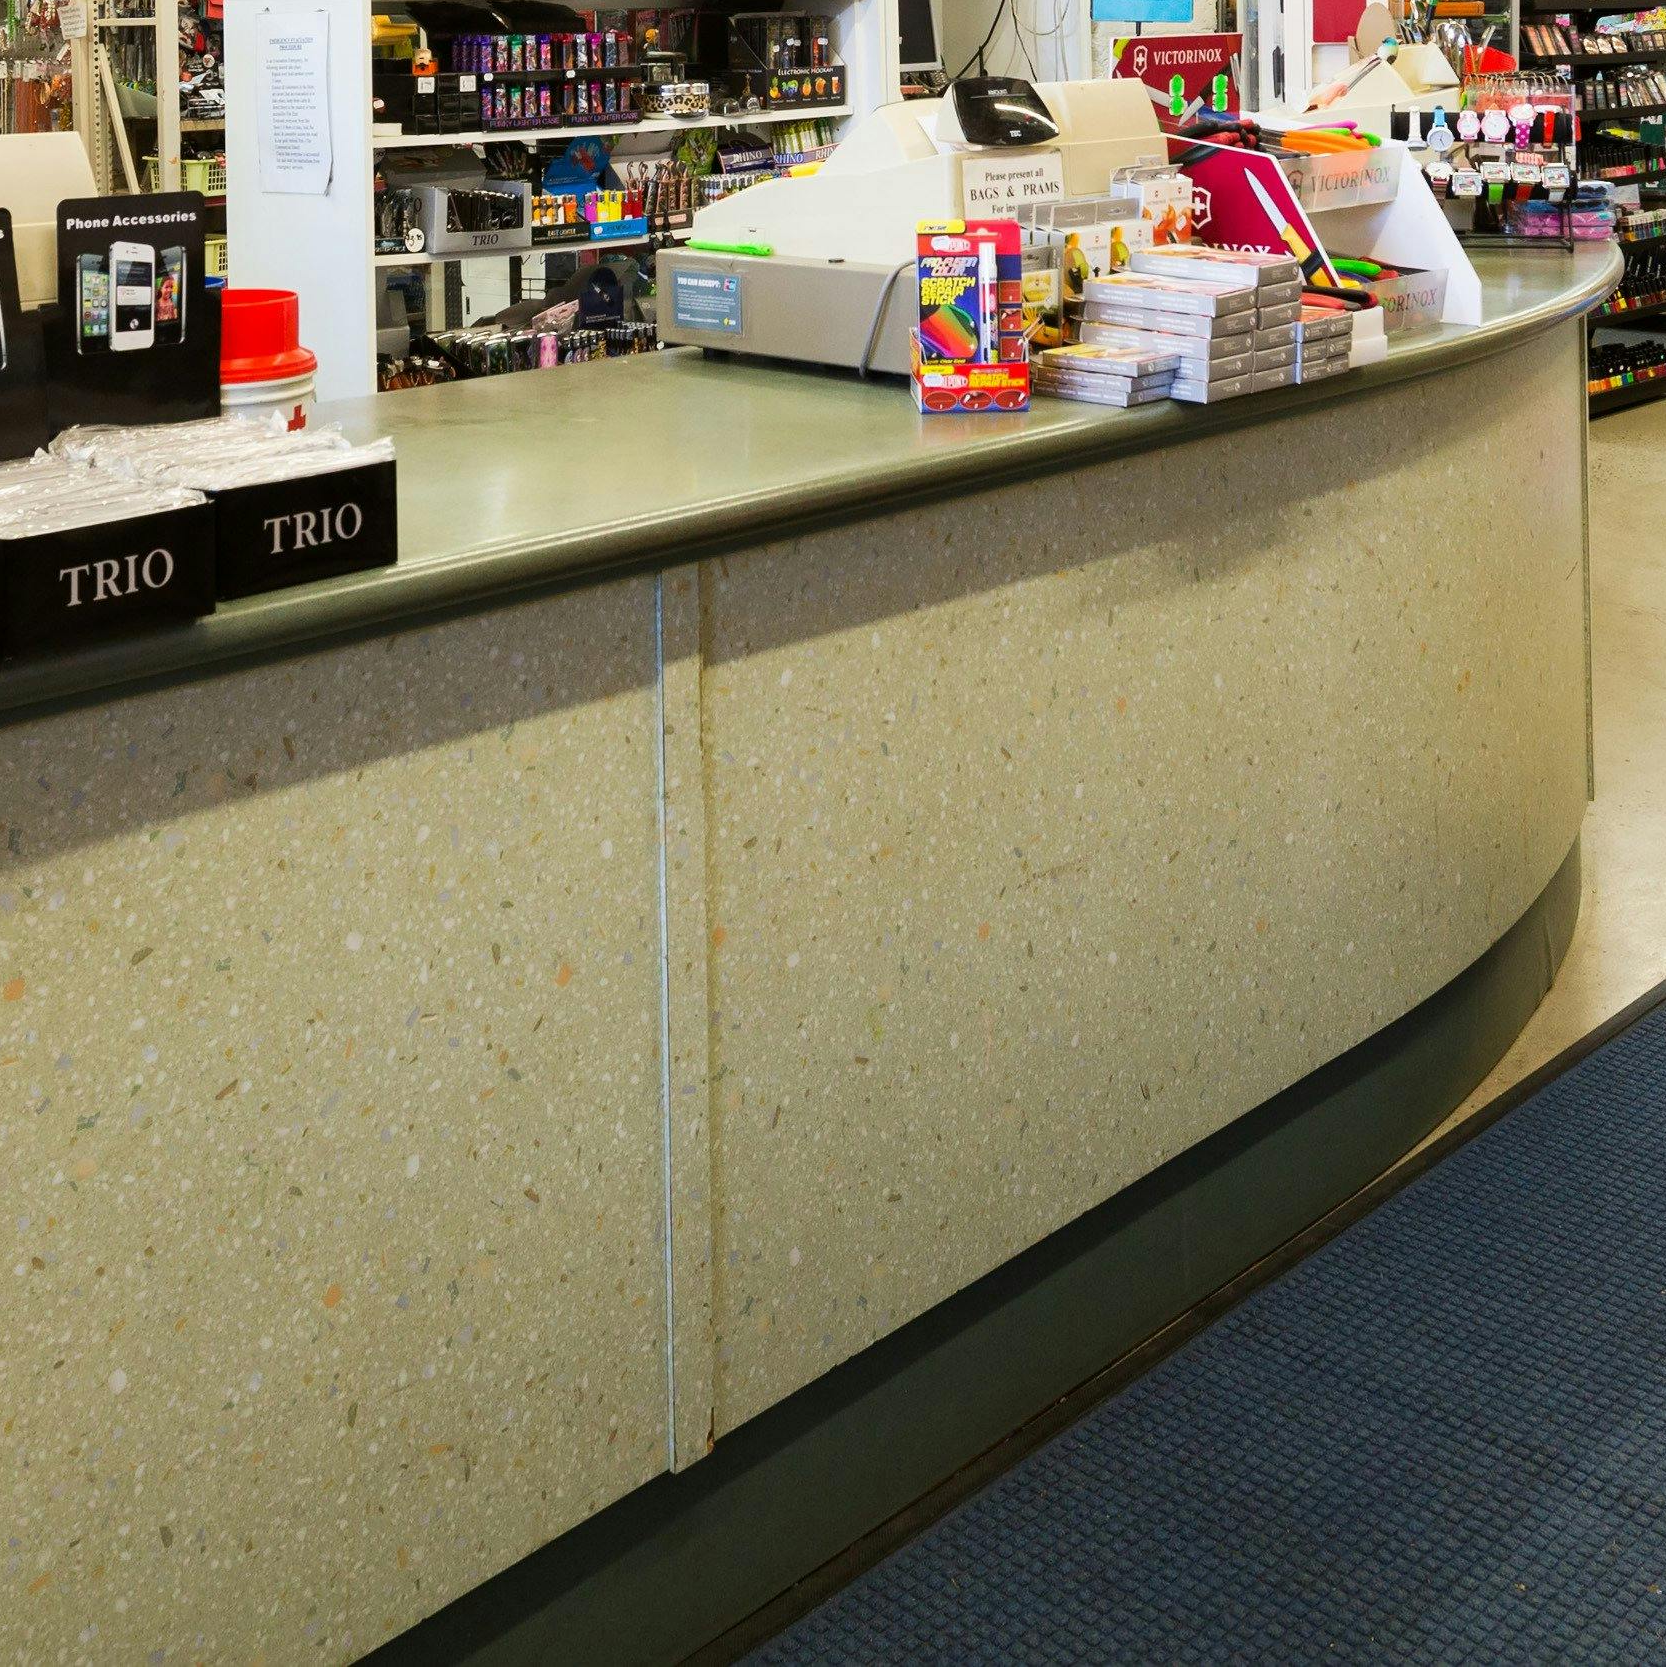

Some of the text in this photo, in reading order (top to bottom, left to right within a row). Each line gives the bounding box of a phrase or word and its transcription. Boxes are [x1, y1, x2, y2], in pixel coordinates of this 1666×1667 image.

[1153, 48, 1222, 66] VICTORINOX
[778, 67, 811, 76] ELECTRONIC
[572, 114, 596, 123] FUNKY
[620, 111, 639, 121] CASE
[733, 149, 763, 162] RHINO
[774, 152, 804, 165] RHINO
[985, 168, 1044, 182] Please present all
[1310, 166, 1391, 193] VICTORINOX
[970, 181, 1060, 201] BAGS & PRAMS
[991, 205, 1005, 214] For
[66, 209, 197, 231] Phone Accessories
[471, 234, 499, 246] TRIO
[920, 276, 977, 288] SCRATCH
[920, 286, 966, 297] REPAIR
[920, 295, 956, 306] STICK
[263, 502, 364, 555] TRIO
[59, 547, 175, 608] TRIO
